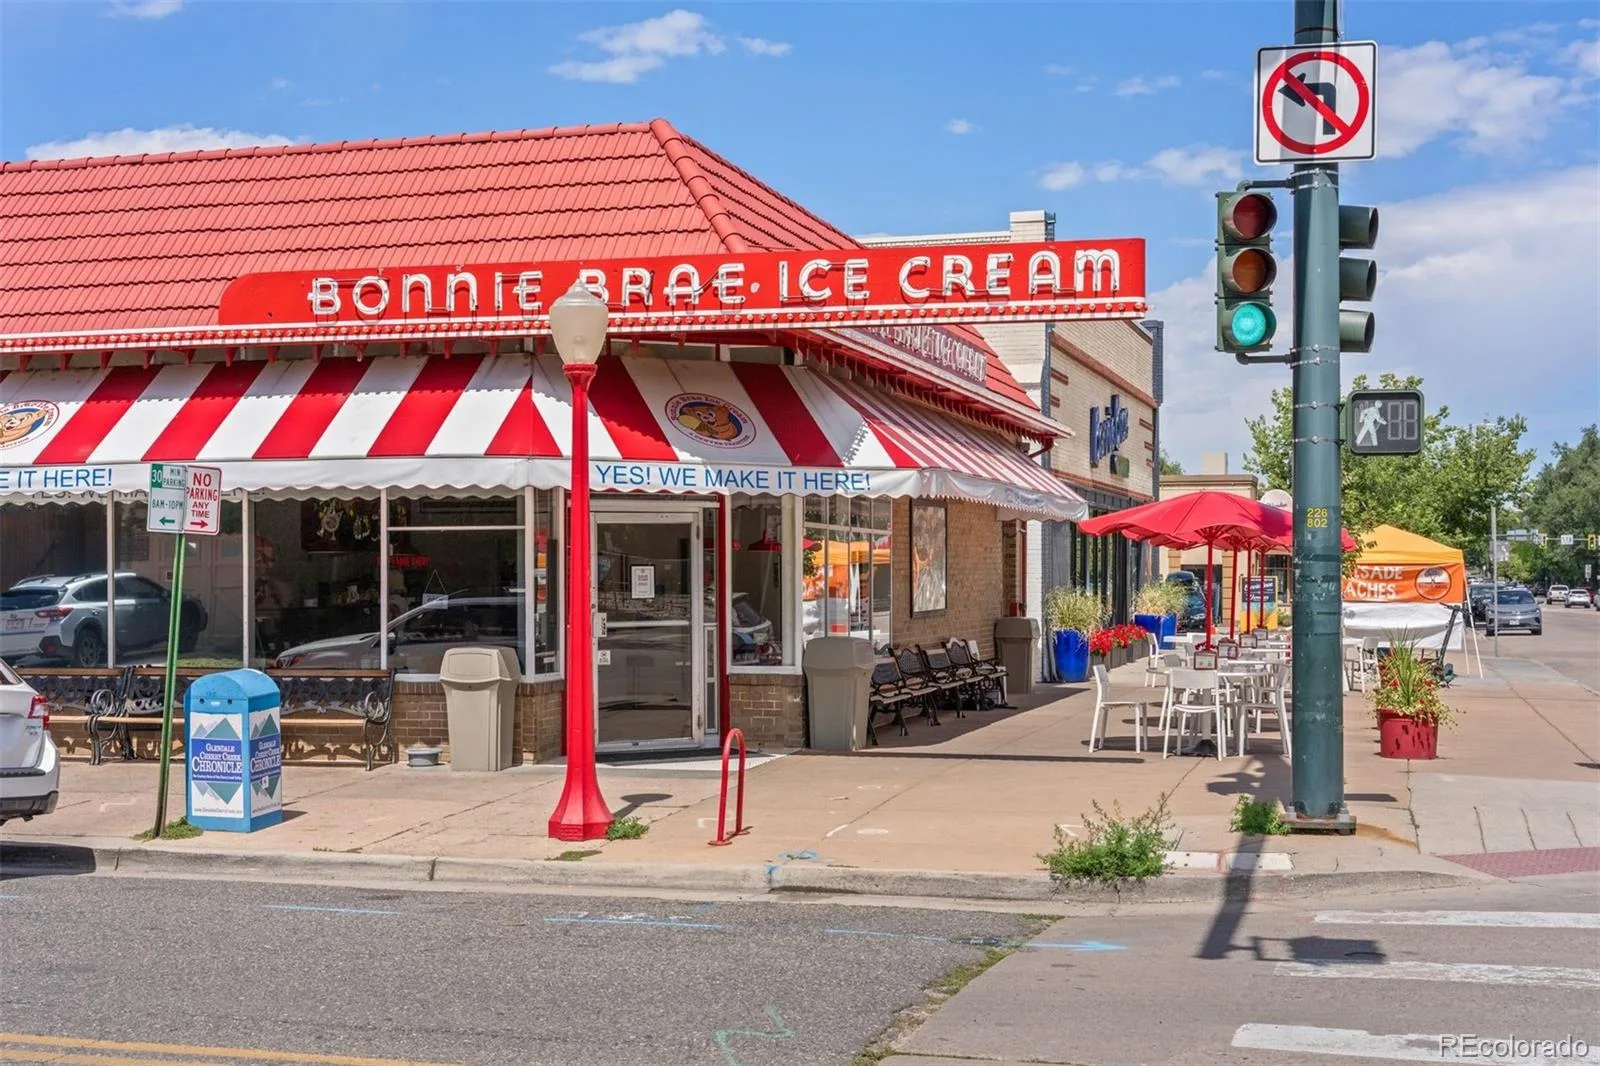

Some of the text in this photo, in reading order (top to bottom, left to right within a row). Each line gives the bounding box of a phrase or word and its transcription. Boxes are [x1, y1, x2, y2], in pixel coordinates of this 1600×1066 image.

[307, 249, 1120, 315] BONNIE BRAE ICE CREAM
[18, 470, 37, 489] IT
[44, 468, 112, 488] HERE!
[151, 470, 162, 483] 30
[170, 468, 181, 477] MIN
[595, 465, 871, 491] YES! WE MAKE IT HERE!
[163, 478, 185, 487] PARKING
[193, 473, 212, 487] NO
[186, 487, 218, 501] PARKING
[192, 502, 210, 510] ANY
[191, 510, 210, 518] TIME
[1307, 508, 1328, 518] 226
[1307, 518, 1328, 528] 802
[1344, 581, 1396, 600] ACHES
